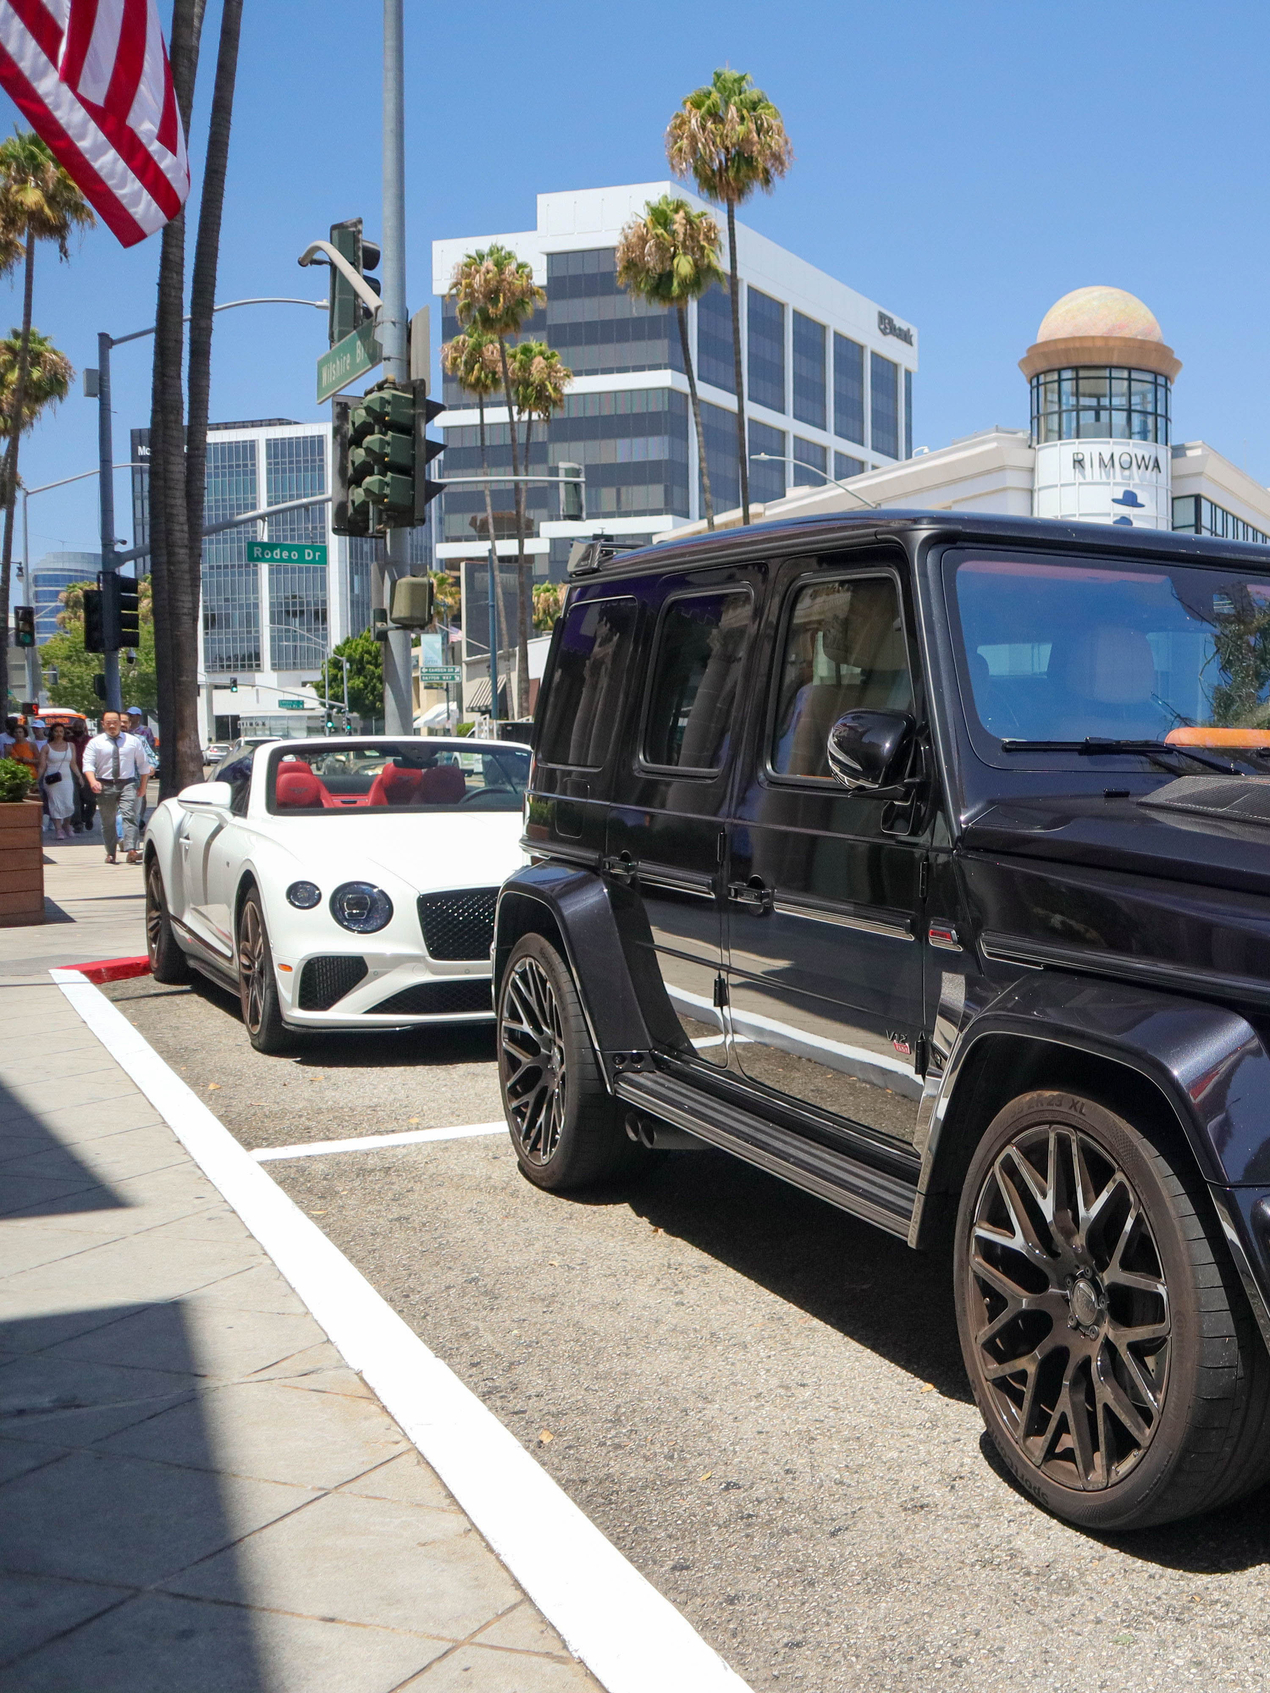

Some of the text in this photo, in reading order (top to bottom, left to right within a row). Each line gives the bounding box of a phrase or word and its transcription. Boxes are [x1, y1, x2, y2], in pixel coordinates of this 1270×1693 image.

[322, 353, 350, 388] Wilshire
[1071, 452, 1161, 473] RIMOWA
[253, 546, 321, 560] Rodeo Dr
[1068, 1098, 1088, 1117] XL
